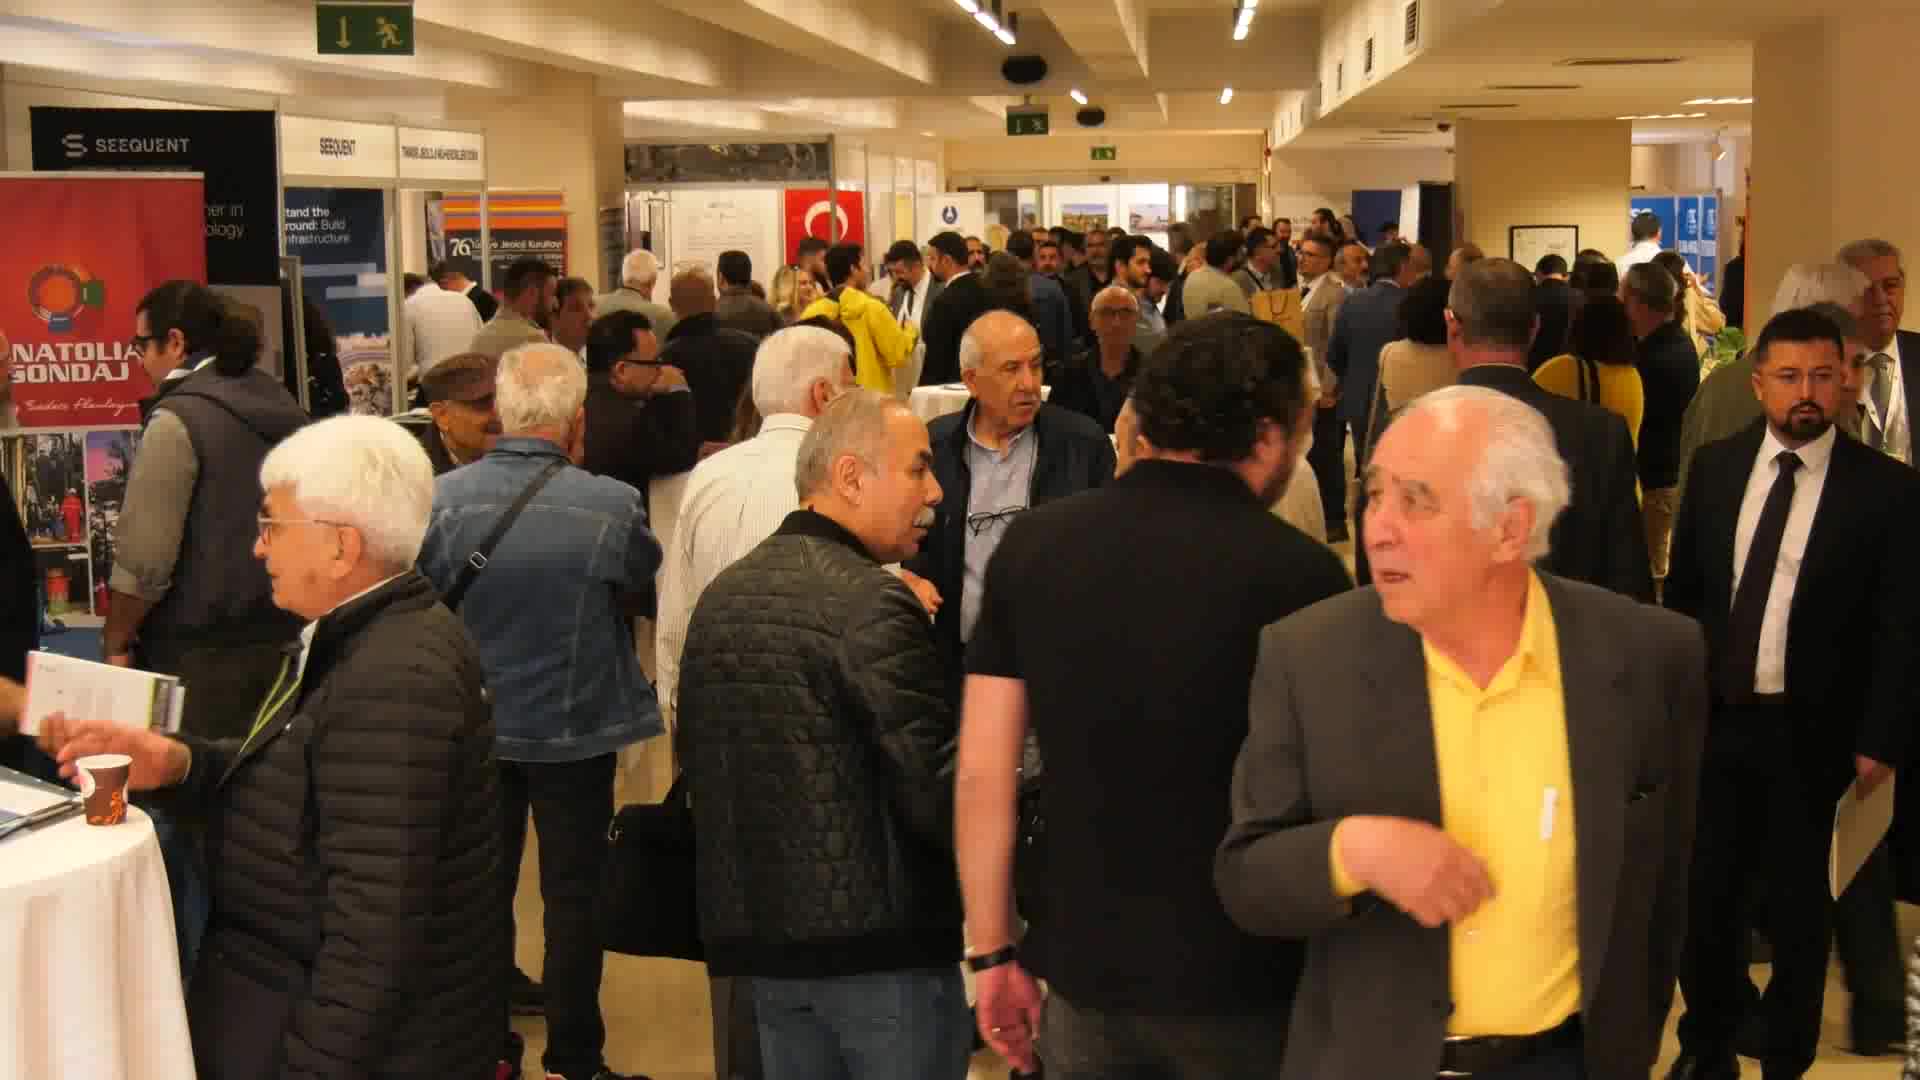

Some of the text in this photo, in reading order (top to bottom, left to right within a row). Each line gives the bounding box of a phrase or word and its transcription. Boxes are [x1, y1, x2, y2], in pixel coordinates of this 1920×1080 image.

[95, 138, 191, 152] SEEQUENT
[286, 205, 331, 217] tand the
[205, 223, 243, 240] ology
[285, 219, 319, 231] round:
[286, 233, 350, 245] nfrastructure
[449, 238, 471, 256] 76
[8, 342, 143, 362] NATOLIA
